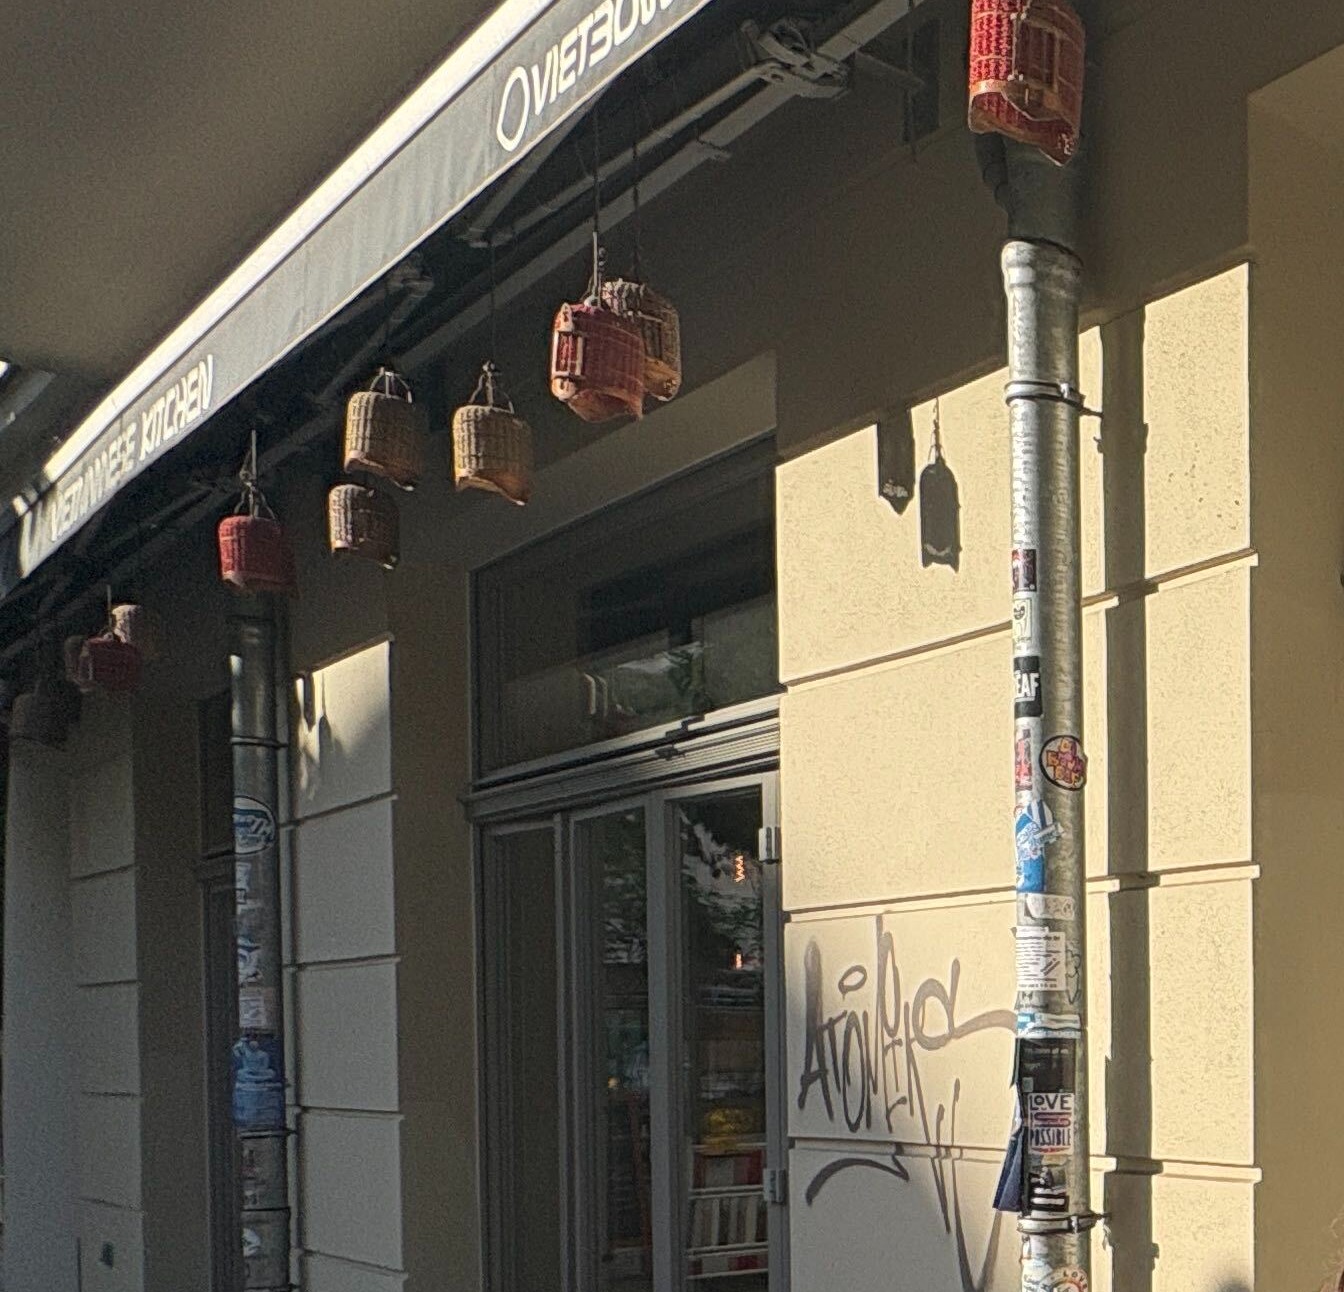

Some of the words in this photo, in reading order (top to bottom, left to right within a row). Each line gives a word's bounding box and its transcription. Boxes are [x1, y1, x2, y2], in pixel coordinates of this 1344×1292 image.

[139, 354, 214, 461] KITCHEN
[1030, 1094, 1072, 1110] LOVE
[1030, 1128, 1071, 1146] POSSIBLE
